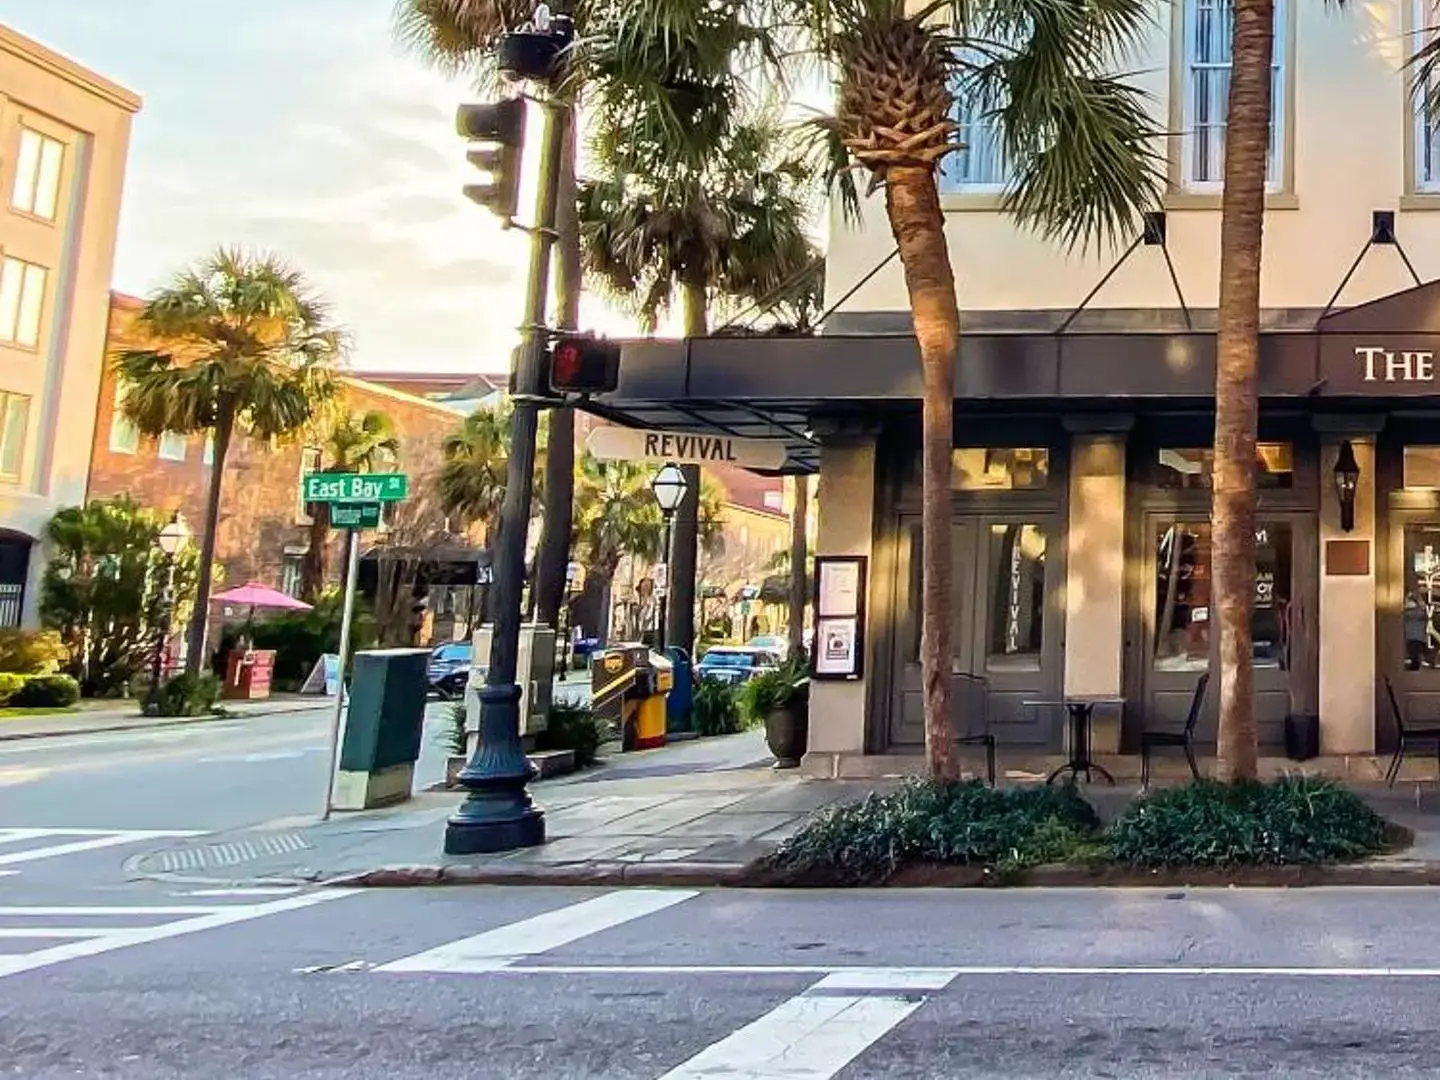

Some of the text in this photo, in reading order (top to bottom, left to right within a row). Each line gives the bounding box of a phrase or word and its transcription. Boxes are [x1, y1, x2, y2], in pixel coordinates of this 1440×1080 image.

[1355, 347, 1434, 381] THE
[645, 433, 737, 461] REVIVAL
[309, 478, 346, 497] East
[351, 477, 383, 499] Bay
